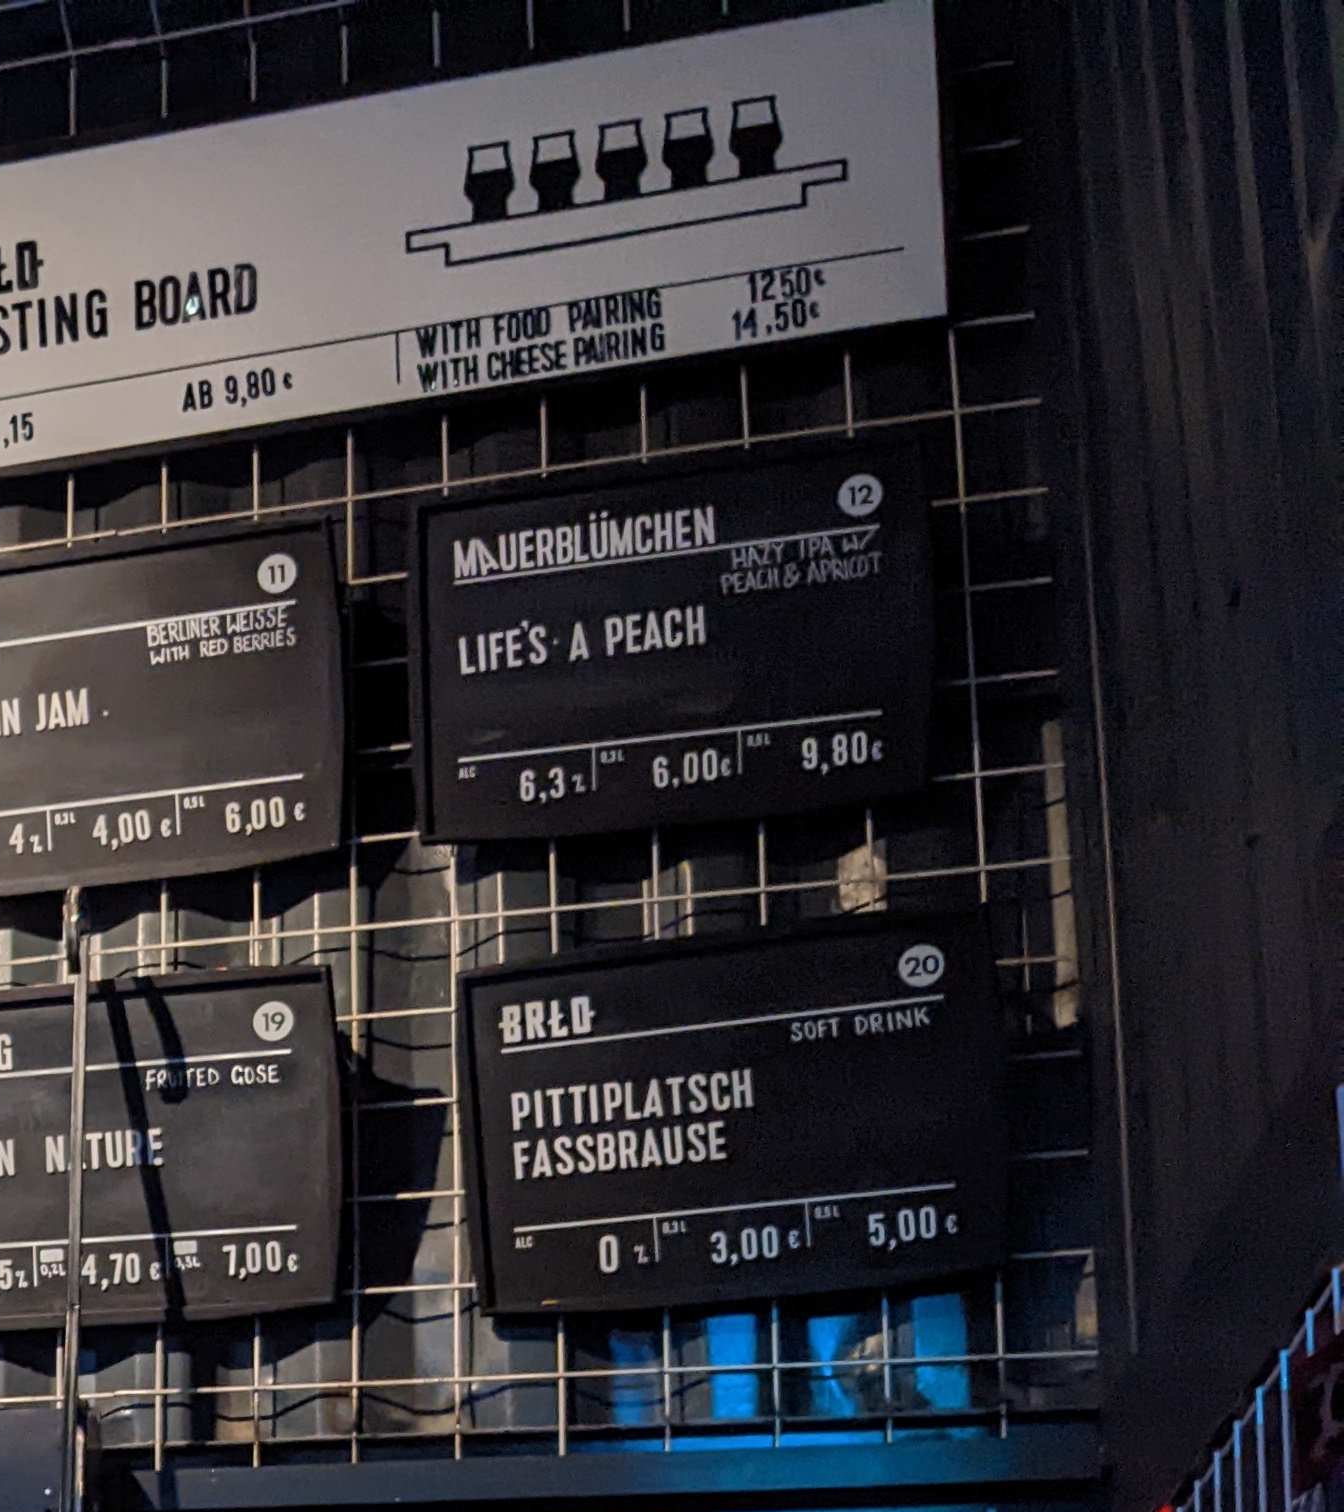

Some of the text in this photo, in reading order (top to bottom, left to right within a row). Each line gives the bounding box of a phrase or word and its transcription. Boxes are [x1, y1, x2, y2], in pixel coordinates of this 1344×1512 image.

[134, 263, 258, 331] BOARD
[416, 289, 662, 359] WITH FOOD PAIRING
[417, 323, 666, 393] WITH CHEESE PAIRING
[182, 381, 213, 413] AB
[453, 485, 874, 580] MAUERBLÜMCHEN 12
[268, 564, 287, 584] 11
[146, 605, 288, 648] BERLINER WEISSE
[150, 628, 297, 665] WITH RED BERRIES
[458, 606, 707, 676] LIFE'S A PEACH
[36, 688, 89, 732] JAM
[904, 955, 940, 977] 20
[261, 1010, 285, 1033] 19
[791, 1006, 931, 1043] SOFT DRINK
[231, 1064, 280, 1085] GOSE
[511, 1068, 755, 1131] PITTIPLATSCH
[511, 1121, 728, 1180] FASSBRAUSE
